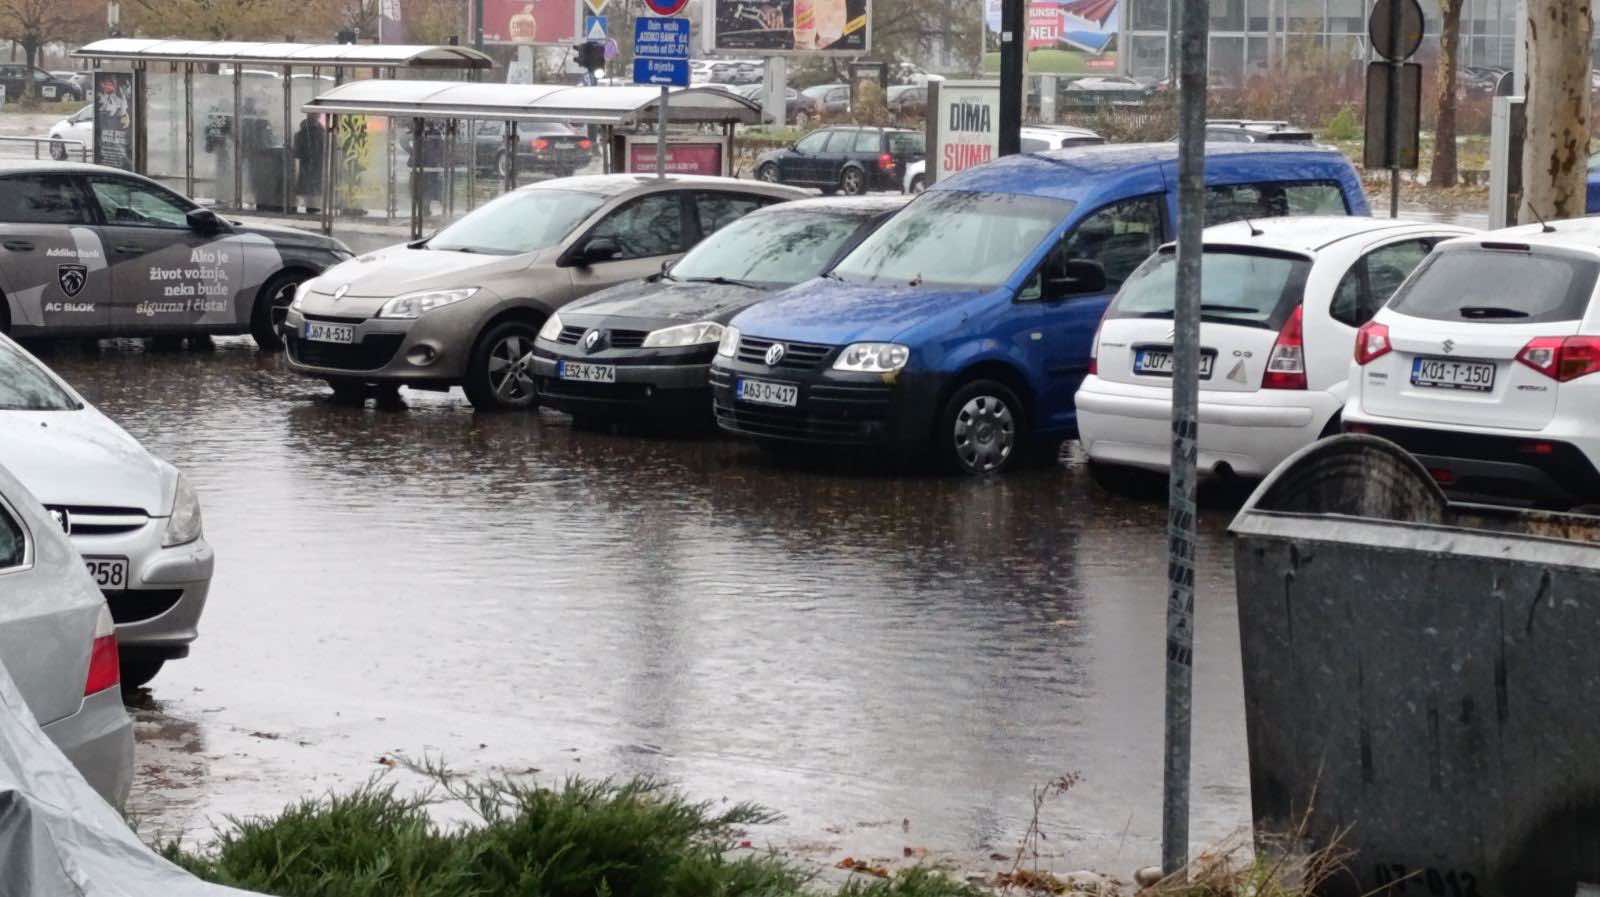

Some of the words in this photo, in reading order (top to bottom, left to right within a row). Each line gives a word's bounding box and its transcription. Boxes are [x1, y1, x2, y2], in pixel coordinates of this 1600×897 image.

[950, 103, 991, 132] DIMA
[46, 248, 77, 257] Addiko
[190, 249, 215, 263] Ako
[217, 249, 229, 266] je
[149, 267, 182, 281] život
[184, 266, 228, 282] vožnja,
[164, 282, 195, 296] neka
[197, 282, 229, 296] bude
[45, 302, 62, 312] AC
[63, 303, 95, 312] BLOK
[136, 300, 184, 317] sigurna
[565, 363, 614, 380] E52-K-374
[1421, 360, 1490, 384] K01-T-150
[86, 561, 123, 586] 258
